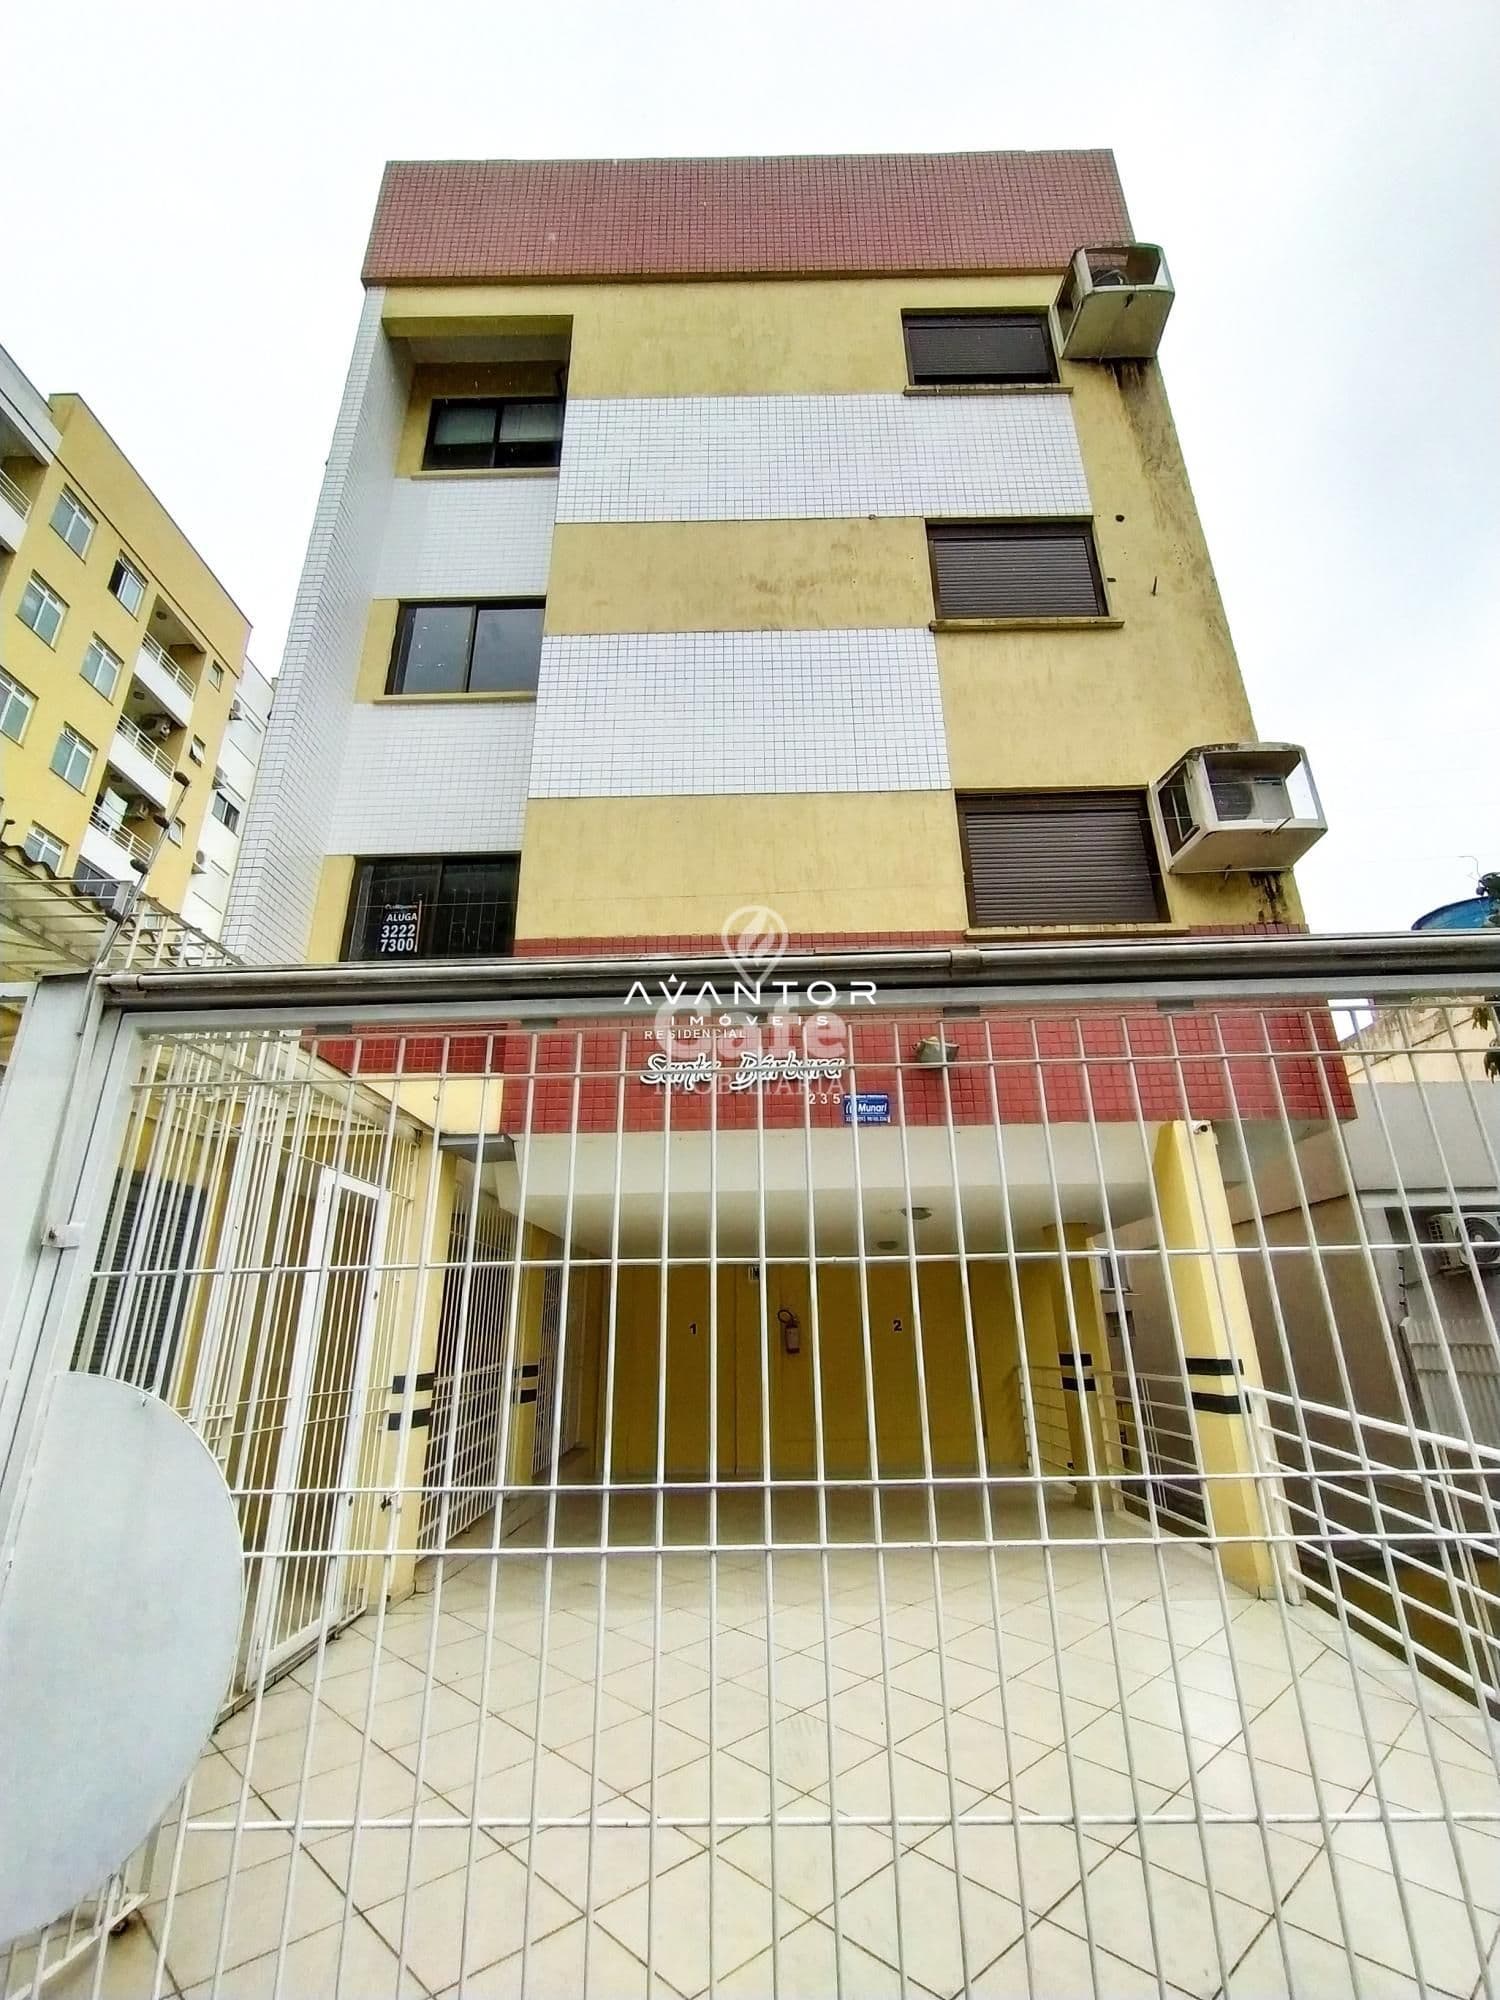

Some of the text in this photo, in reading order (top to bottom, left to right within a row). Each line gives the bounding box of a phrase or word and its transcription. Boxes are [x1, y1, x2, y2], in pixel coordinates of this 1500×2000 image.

[386, 912, 417, 921] ALUGA
[381, 924, 416, 938] 3222
[380, 937, 414, 953] 7300
[643, 1028, 746, 1041] RESIDENCIAL
[809, 1093, 841, 1106] 235
[690, 1323, 698, 1335] 1
[893, 1319, 903, 1332] 2
